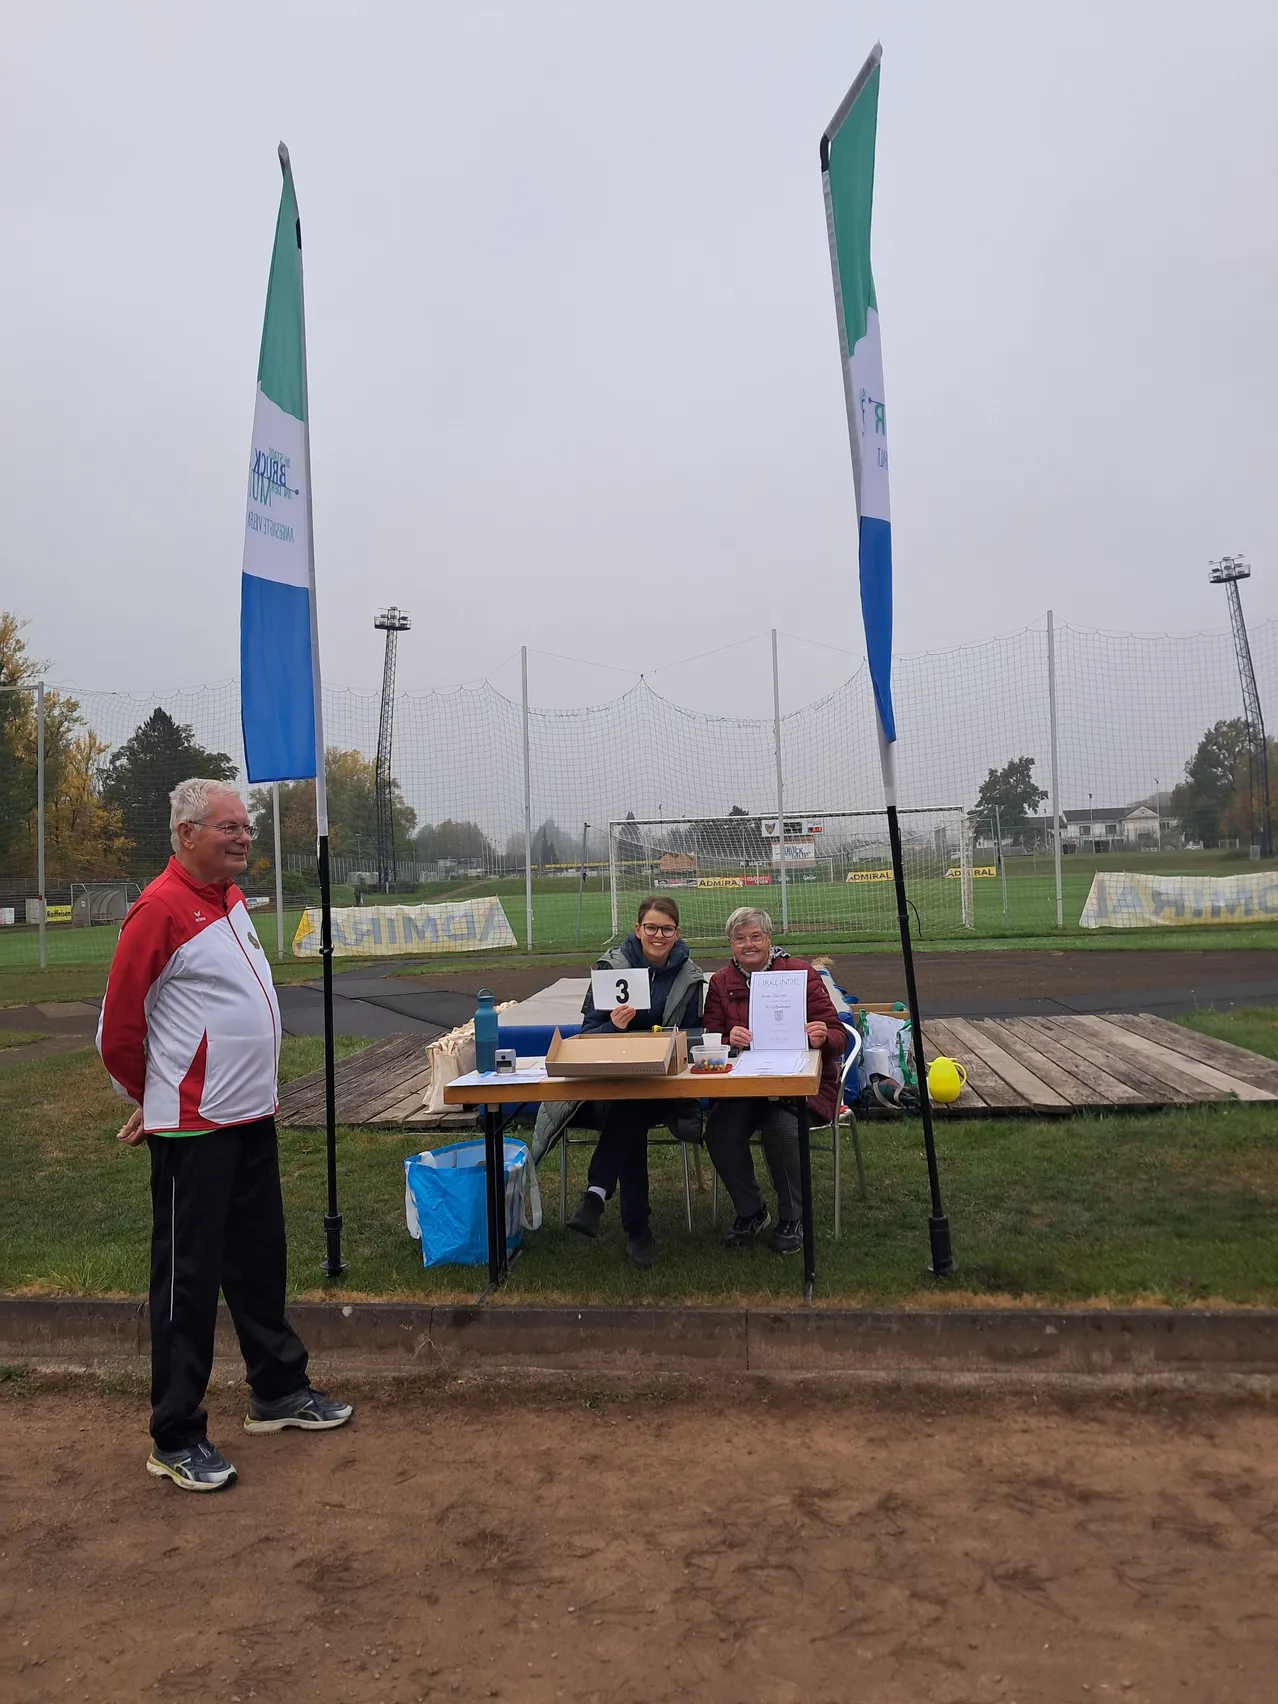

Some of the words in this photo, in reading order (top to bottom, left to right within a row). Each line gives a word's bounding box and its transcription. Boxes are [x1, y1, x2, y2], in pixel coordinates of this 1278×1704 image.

[699, 879, 738, 887] ADMIRA
[46, 908, 71, 918] Raiffeisen
[757, 978, 801, 987] URKUNDE
[615, 978, 629, 1004] 3
